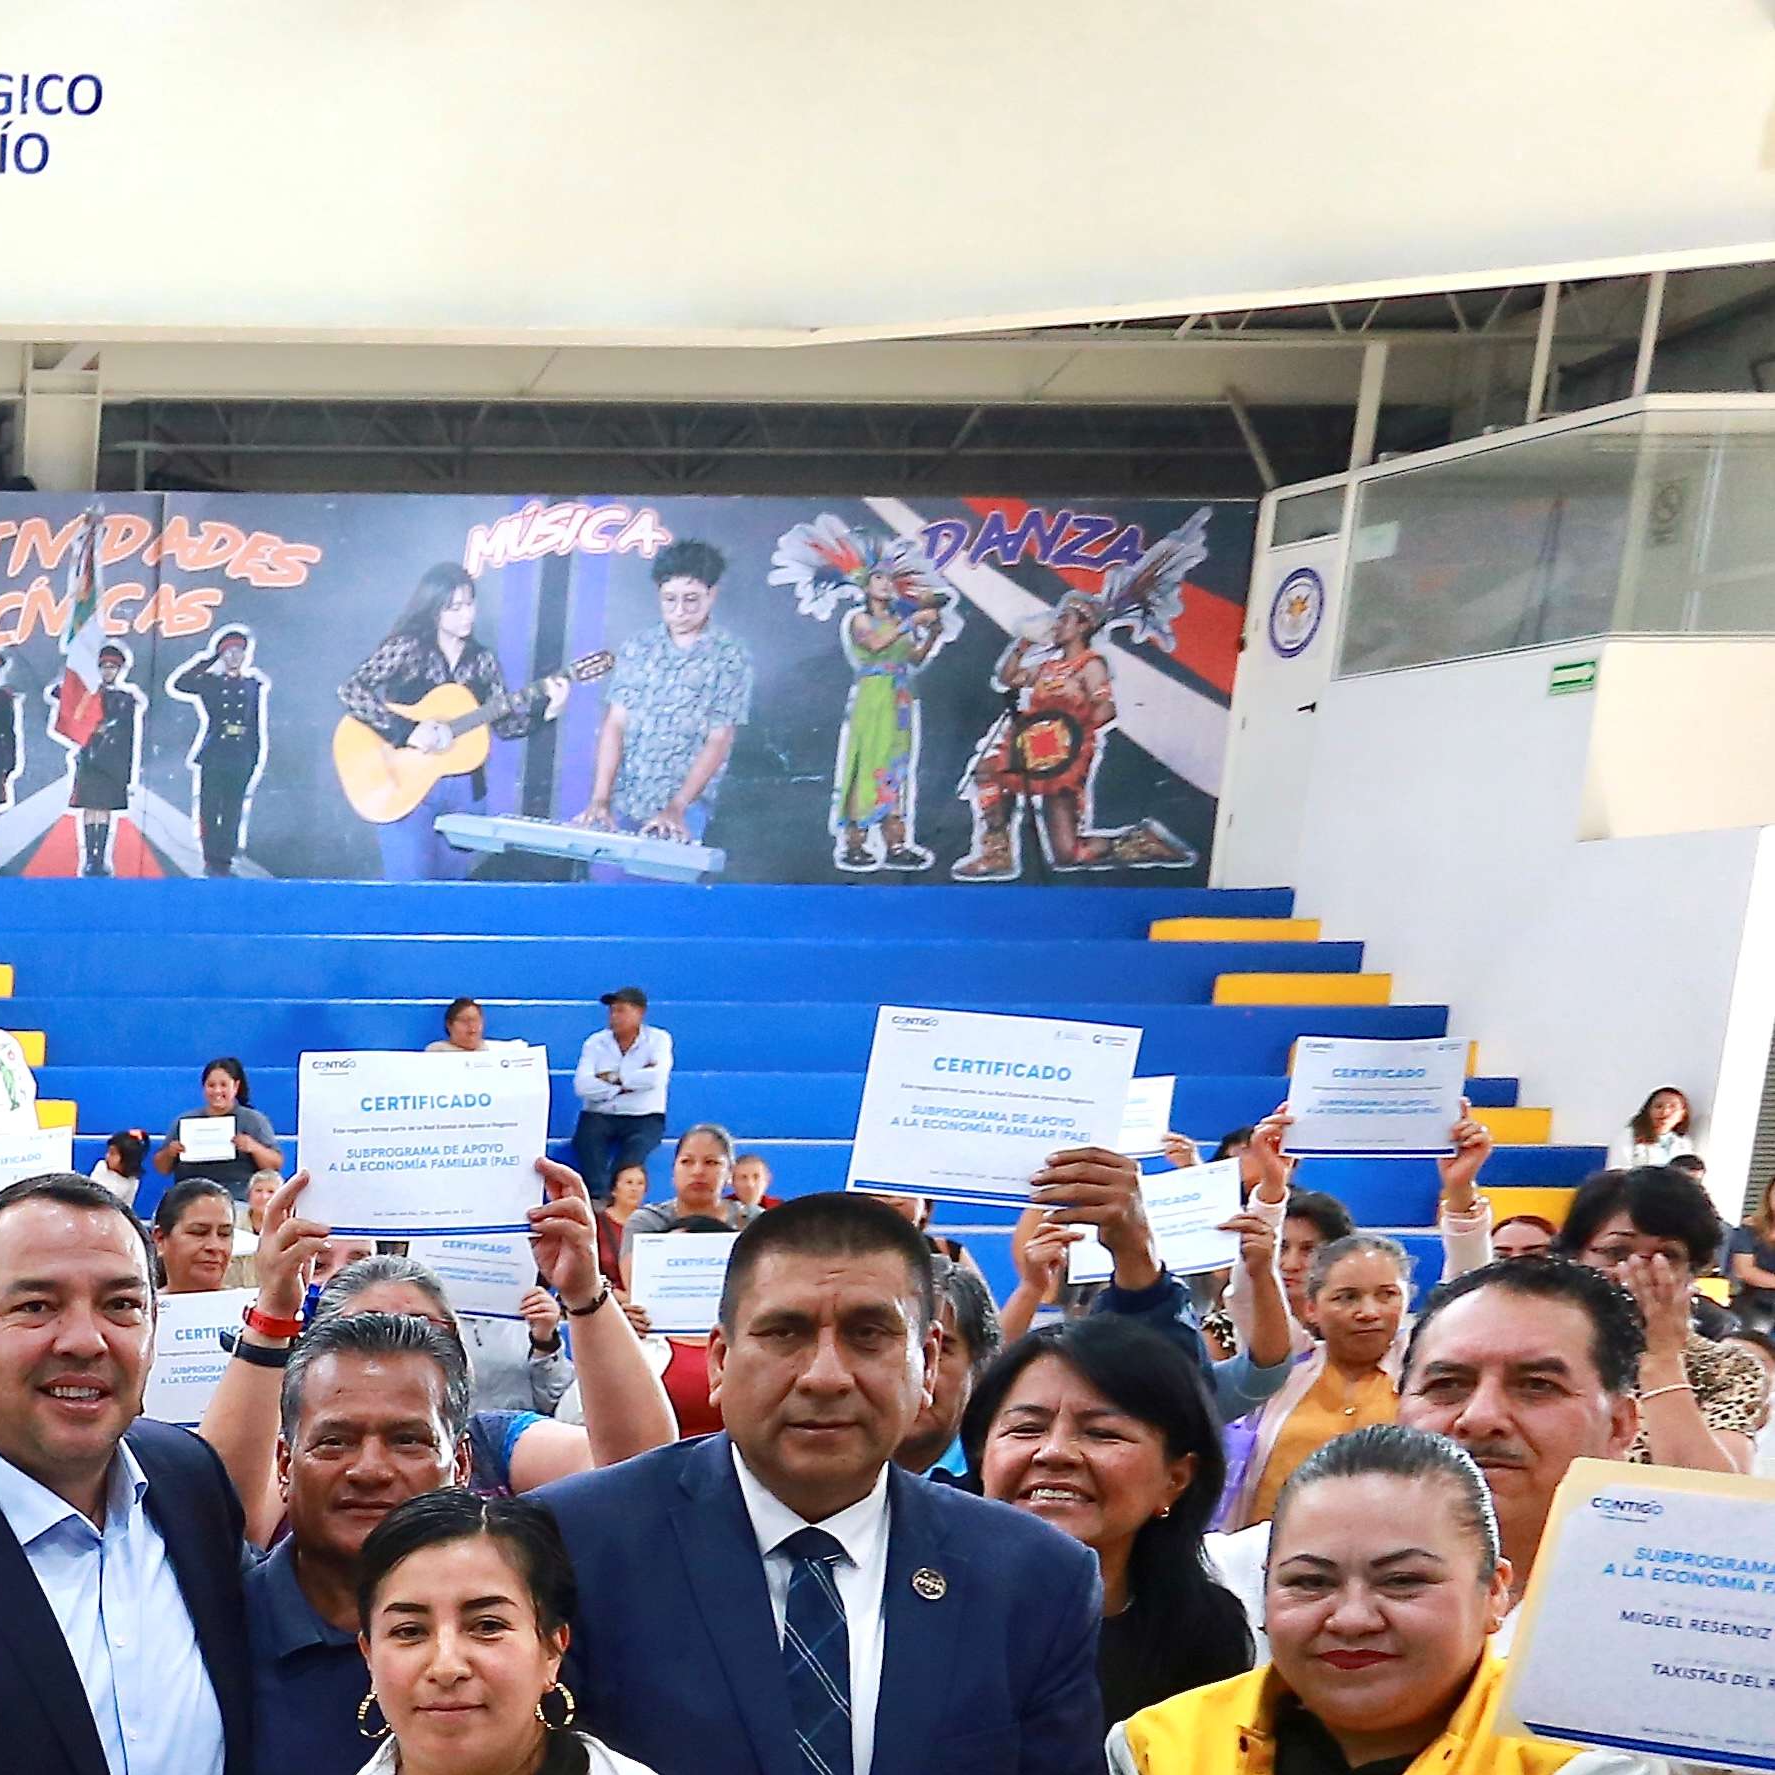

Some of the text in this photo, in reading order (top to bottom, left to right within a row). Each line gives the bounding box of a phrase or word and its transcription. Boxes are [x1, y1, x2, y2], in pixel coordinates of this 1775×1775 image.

[464, 500, 673, 578] MÚSICA
[920, 509, 1151, 573] DANZA
[932, 1056, 1072, 1082] CERTIFICADO
[360, 1092, 492, 1112] CERTIFICADO
[1591, 1497, 1664, 1516] CONTIGO
[1618, 1609, 1772, 1640] MIGUEL RESENDIZ
[1651, 1663, 1762, 1689] TAXISTAS DEL
